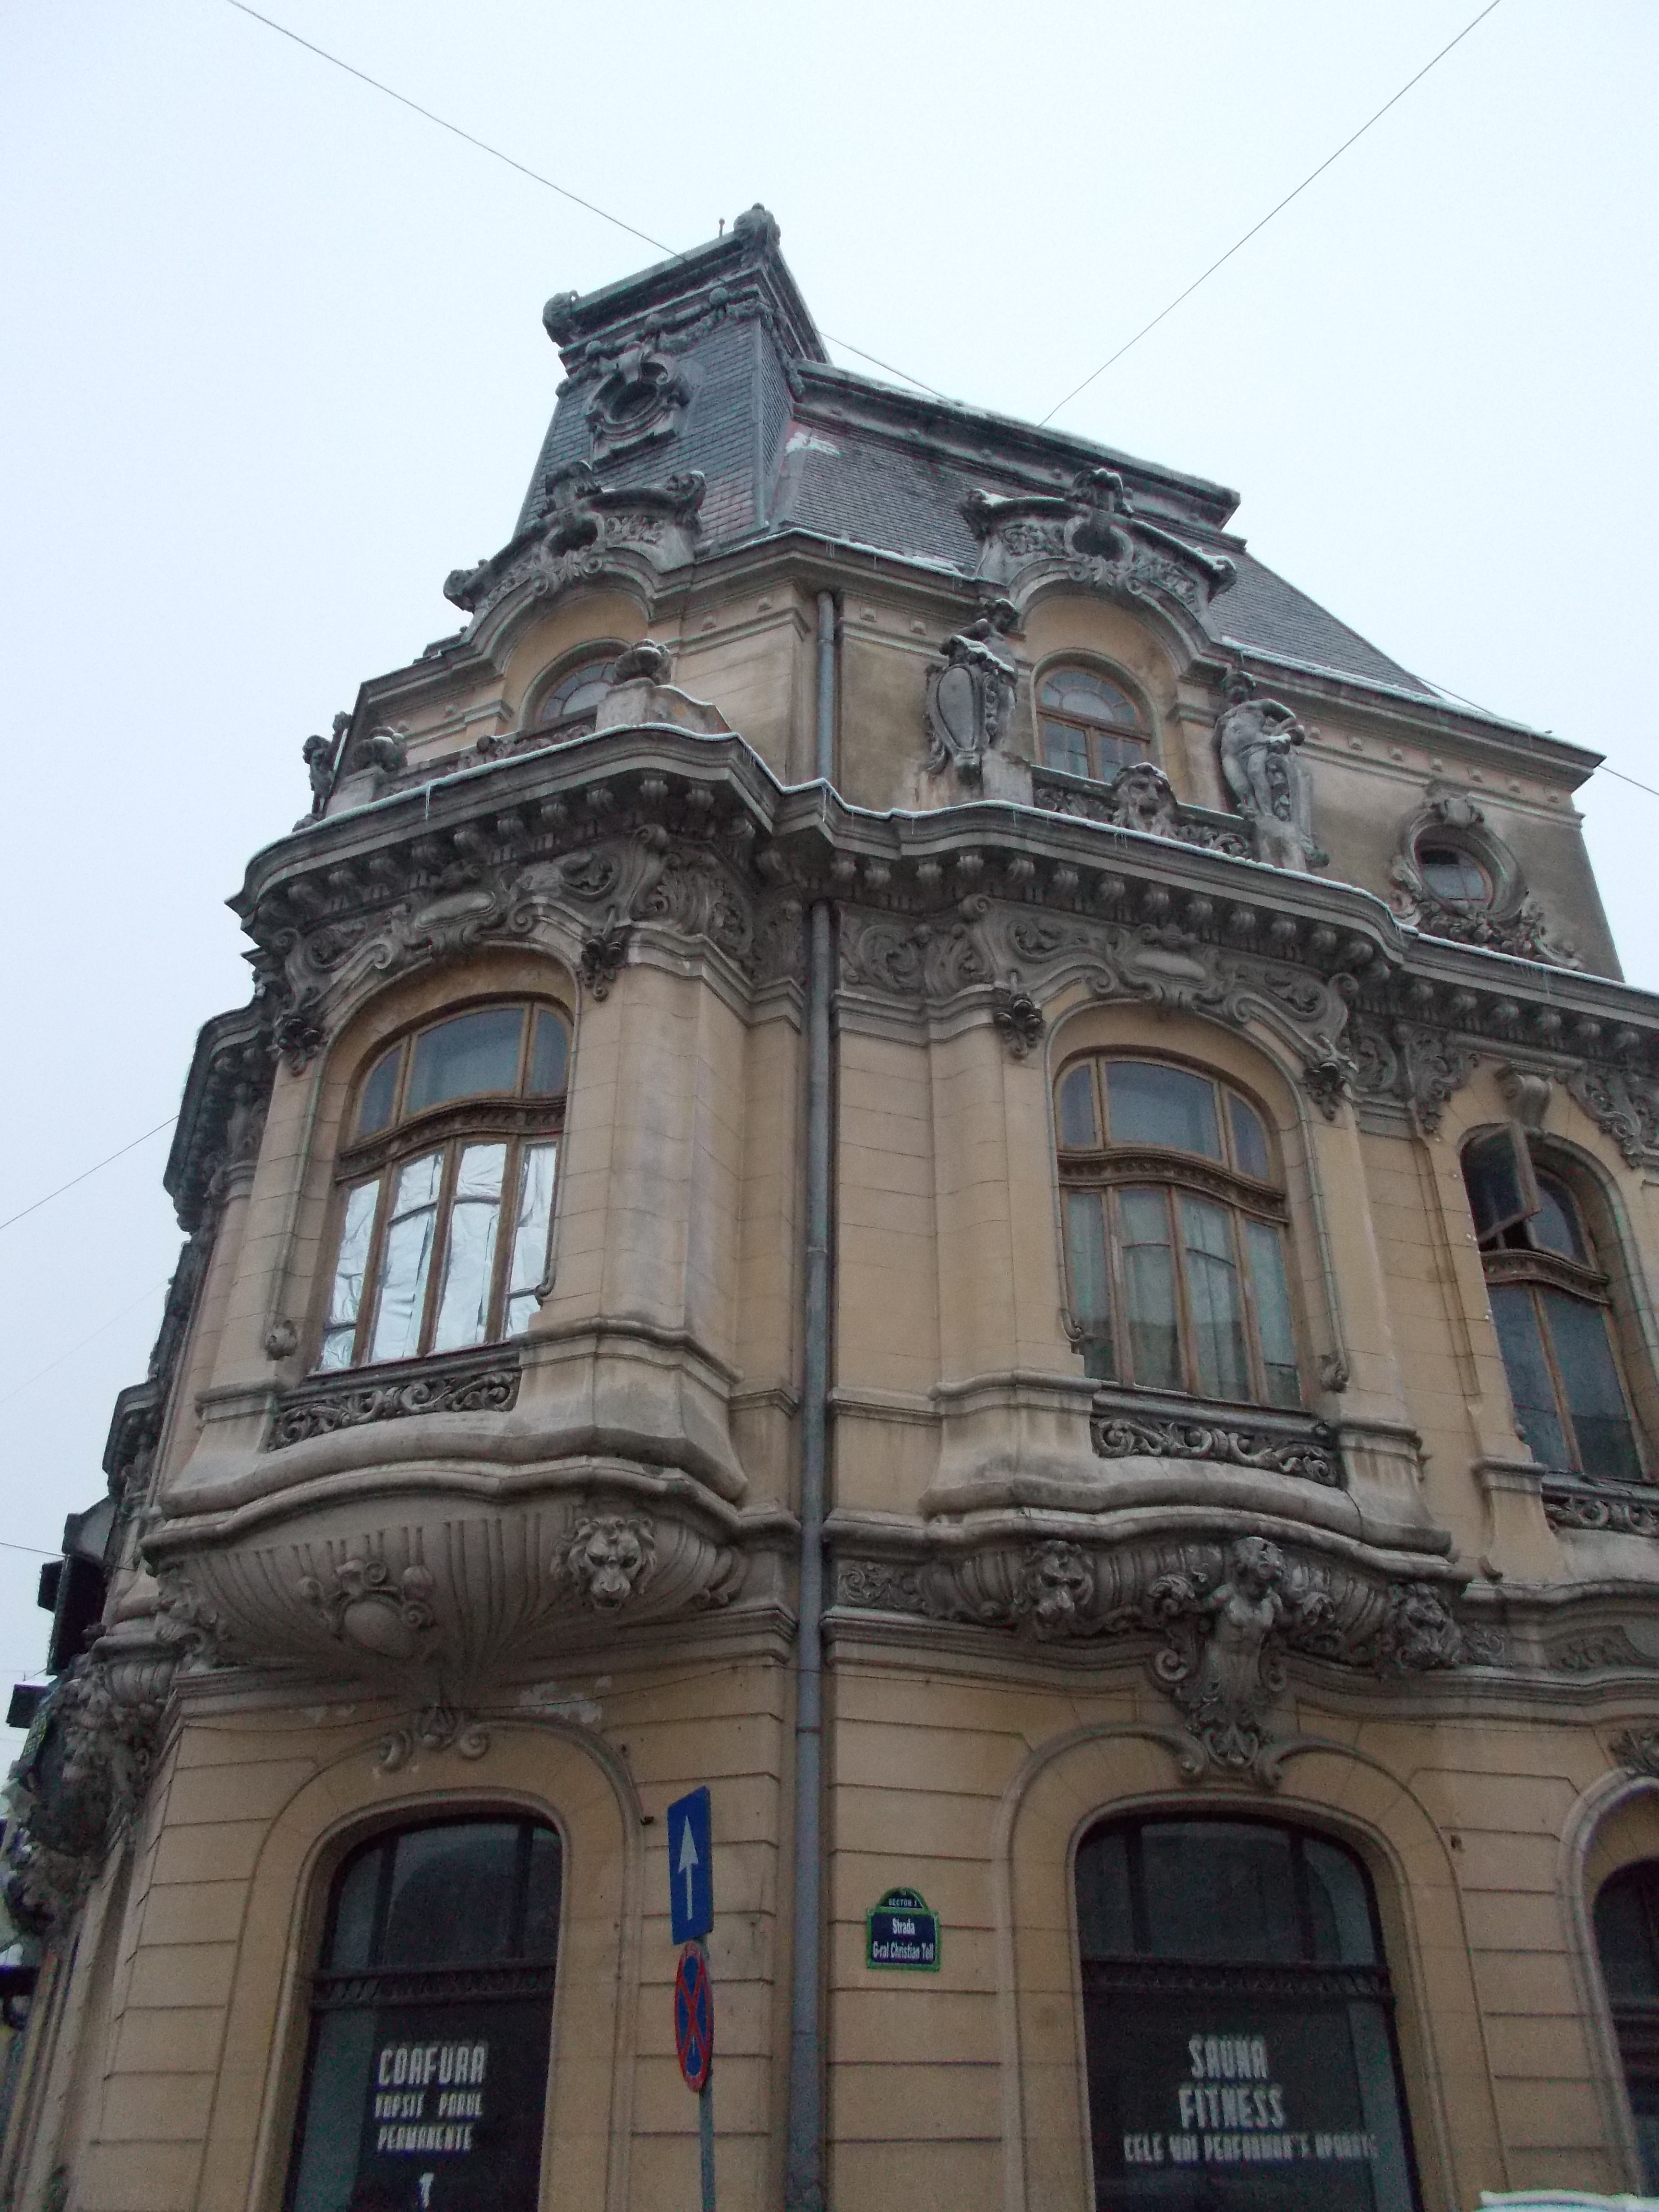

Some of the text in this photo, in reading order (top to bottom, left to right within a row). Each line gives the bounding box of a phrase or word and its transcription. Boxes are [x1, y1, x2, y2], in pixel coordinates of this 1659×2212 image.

[889, 1898, 912, 1907] SECTOR
[892, 1918, 915, 1935] Strada
[890, 1942, 920, 1959] Christian
[921, 1943, 934, 1960] Tell
[378, 2044, 487, 2086] COAFURA
[1189, 2035, 1269, 2079] SAUNA
[1178, 2084, 1286, 2128] FITNESS
[377, 2124, 474, 2151] PERMANENTE
[1168, 2134, 1199, 2161] MAI
